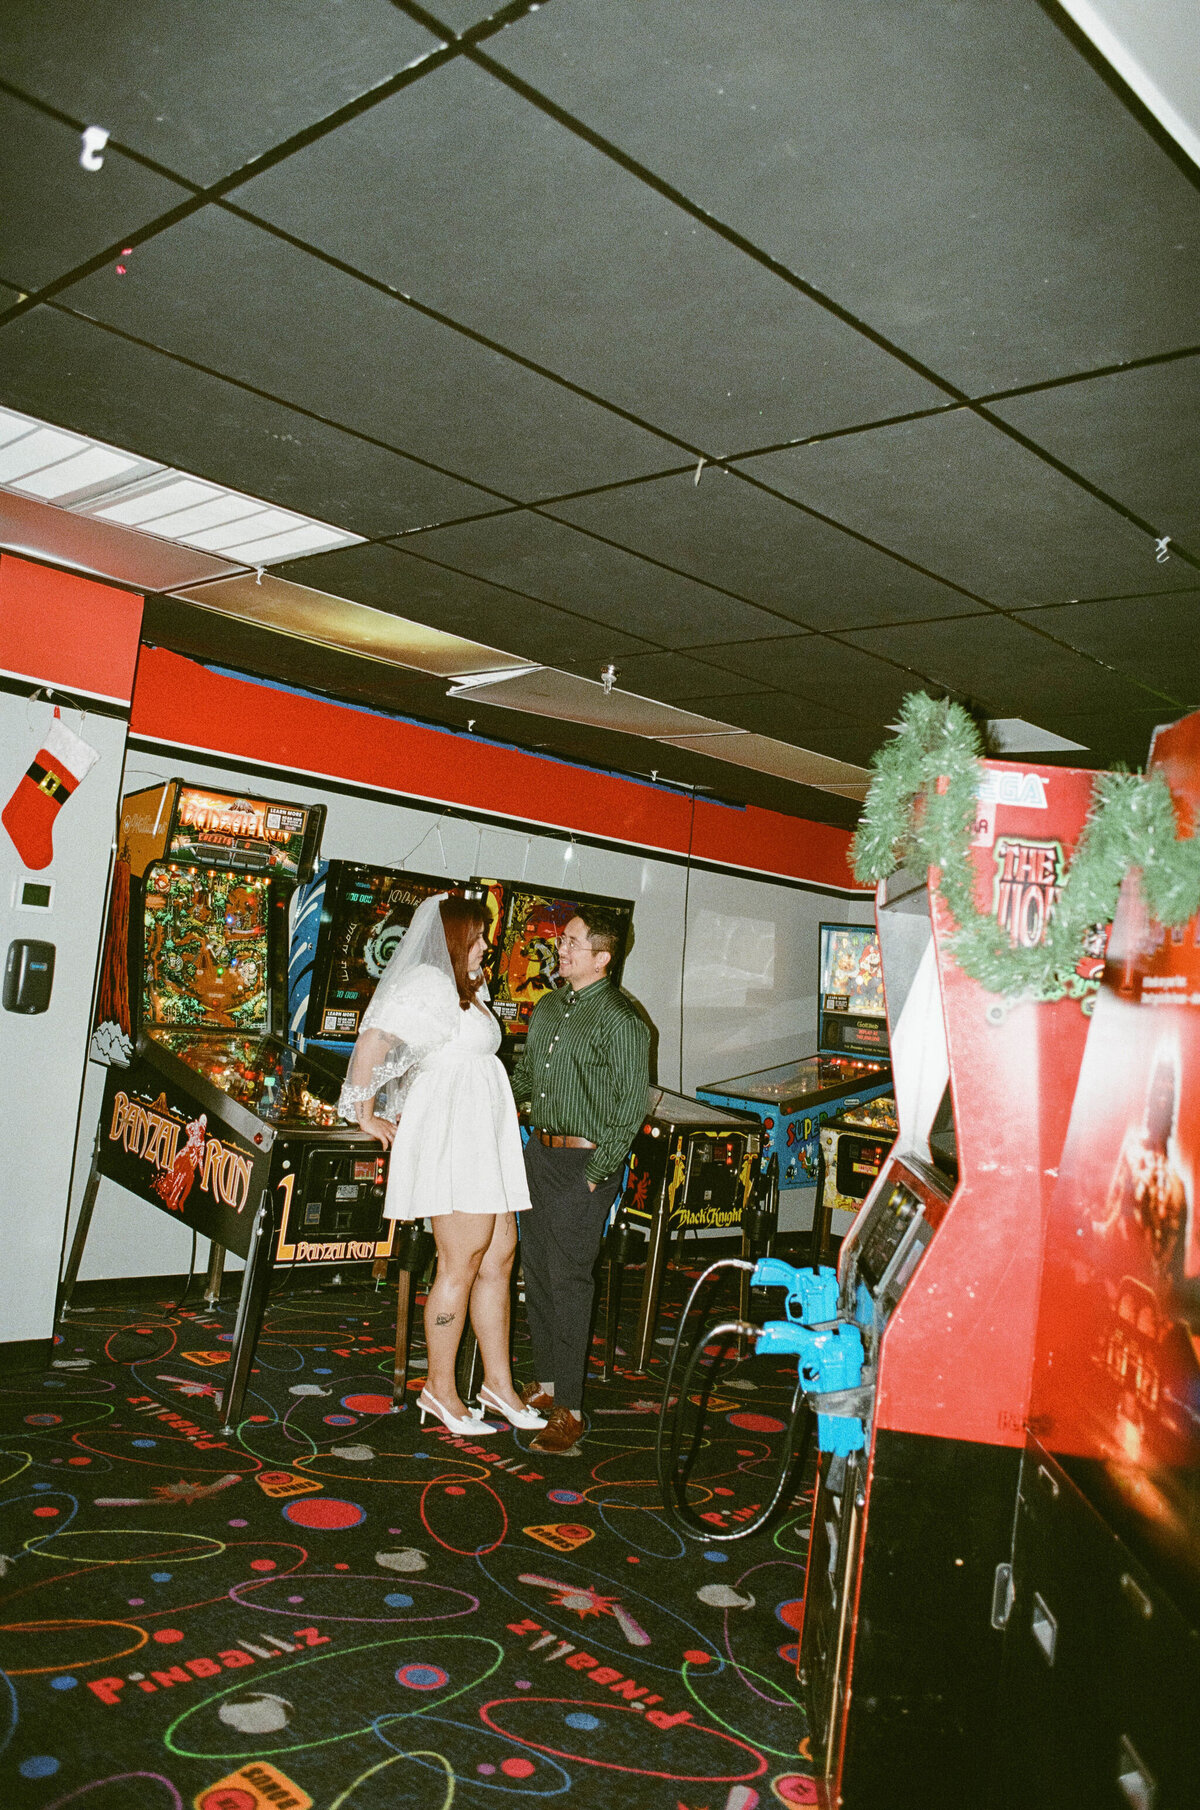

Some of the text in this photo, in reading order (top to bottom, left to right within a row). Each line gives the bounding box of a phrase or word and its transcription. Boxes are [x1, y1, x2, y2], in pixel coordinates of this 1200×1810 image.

[975, 772, 1046, 807] EGA
[270, 808, 302, 818] LEARN MORE
[1000, 842, 1056, 886] THE
[109, 1090, 254, 1214] BANZAI RUN
[296, 1240, 375, 1262] BANZAI RUN
[240, 1766, 300, 1809] BONUS
